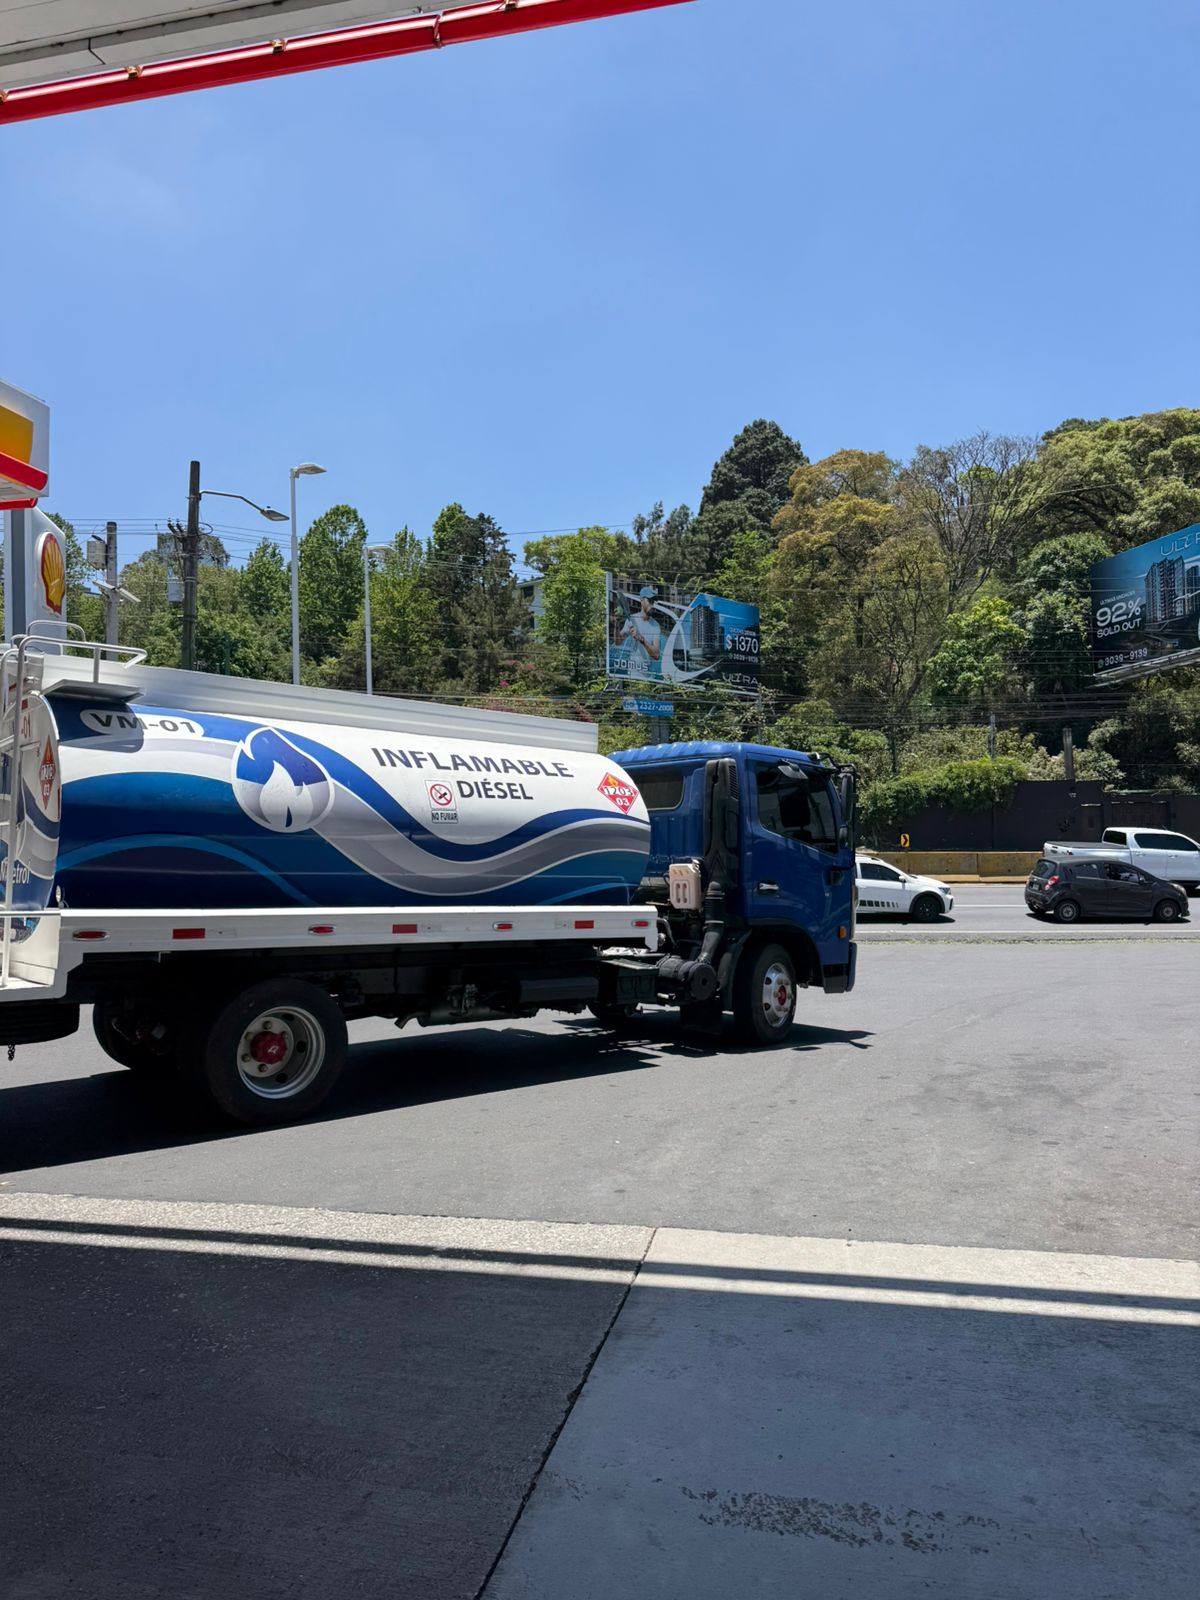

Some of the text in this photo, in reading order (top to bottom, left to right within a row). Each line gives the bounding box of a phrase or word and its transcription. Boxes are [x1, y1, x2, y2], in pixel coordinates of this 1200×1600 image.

[1096, 597, 1142, 627] 92%
[1096, 617, 1142, 639] SOLD OUT
[89, 712, 197, 734] VM-01
[371, 747, 574, 778] INFLAMABLE
[456, 778, 534, 800] DIÉSEL
[604, 786, 634, 796] 1203
[615, 797, 630, 807] 03
[431, 812, 459, 821] NO FUMAR
